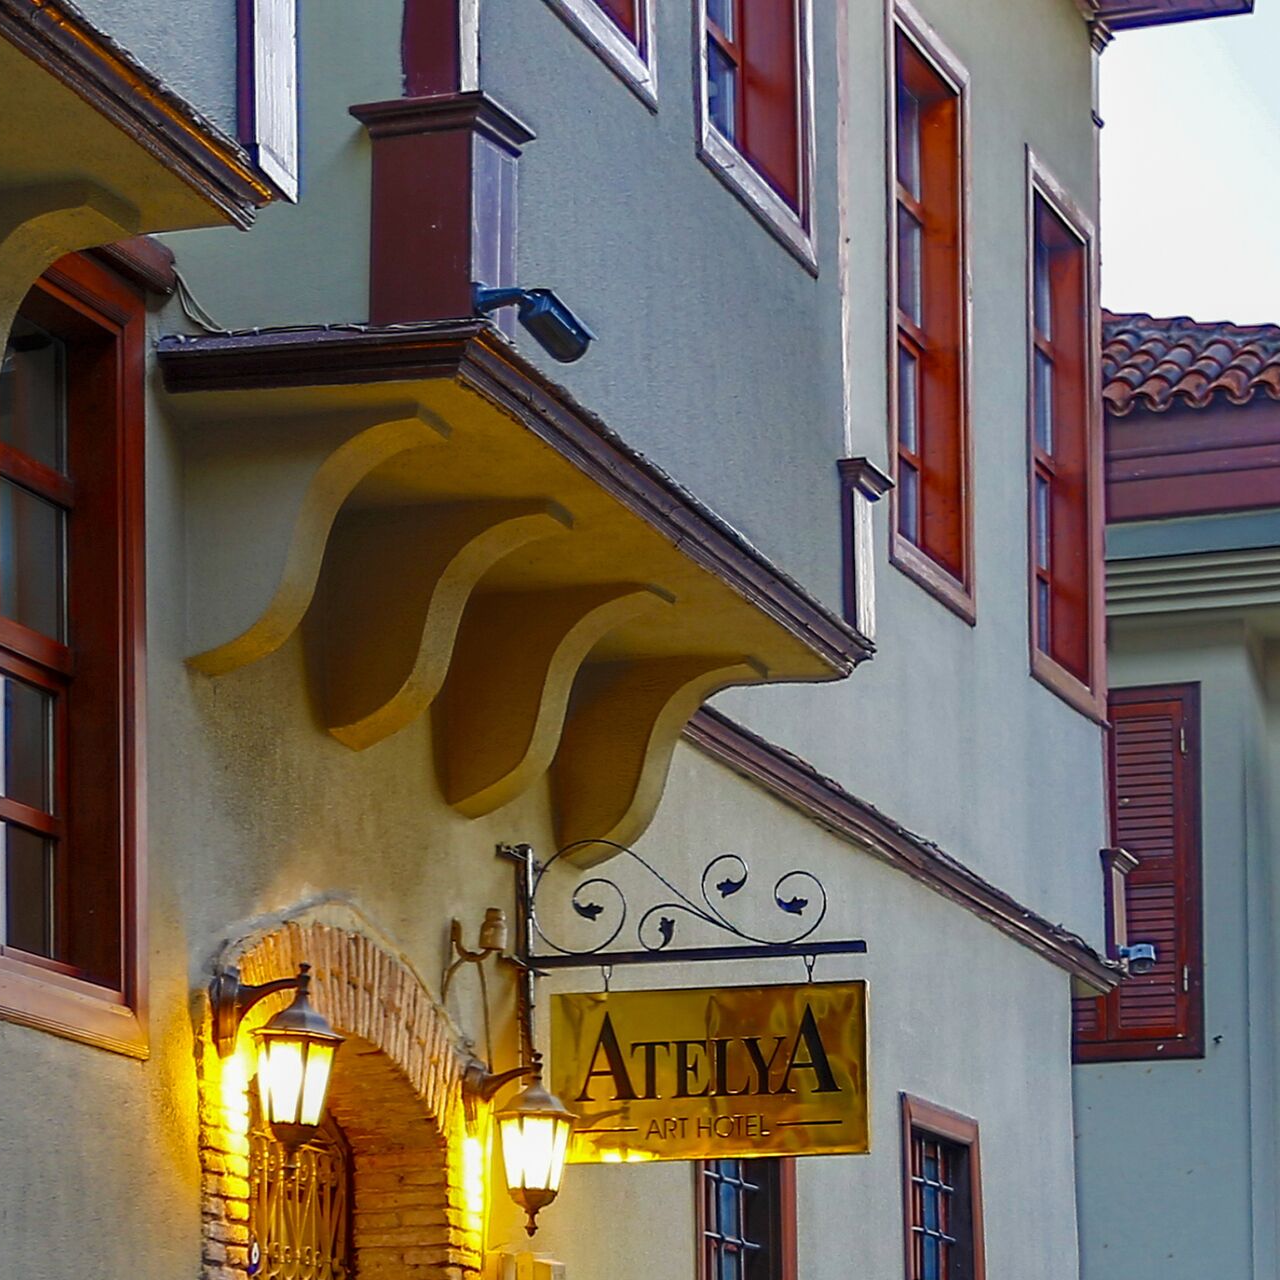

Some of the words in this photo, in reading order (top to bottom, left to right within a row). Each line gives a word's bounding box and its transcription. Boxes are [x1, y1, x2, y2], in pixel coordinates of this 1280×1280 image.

[574, 1002, 842, 1102] ATELYA
[645, 1117, 688, 1140] ART
[696, 1114, 770, 1139] HOTEL
